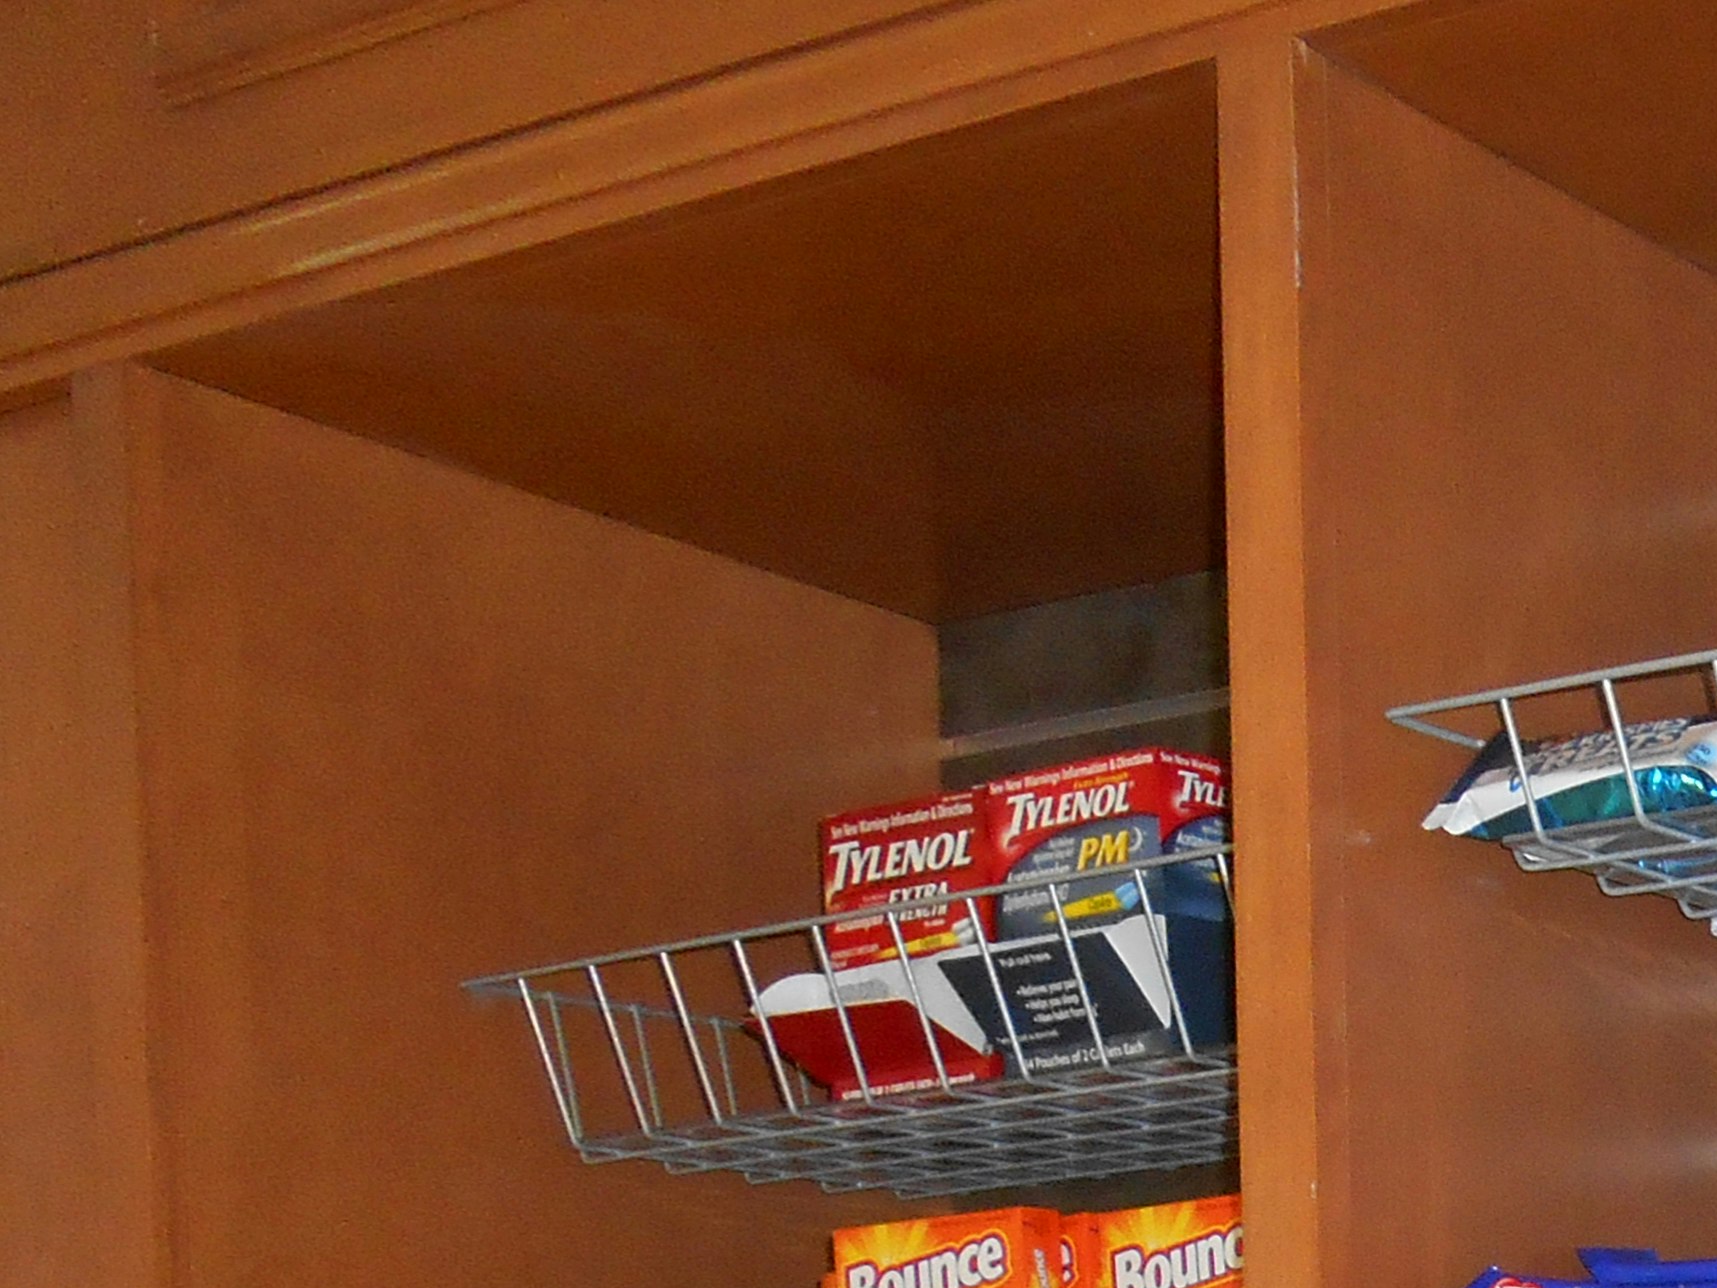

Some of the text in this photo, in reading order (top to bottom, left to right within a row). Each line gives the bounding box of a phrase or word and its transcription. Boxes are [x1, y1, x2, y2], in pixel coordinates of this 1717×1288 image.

[1004, 781, 1130, 848] TYLENOL
[828, 830, 973, 894] TYLENOL
[1077, 831, 1131, 871] PM
